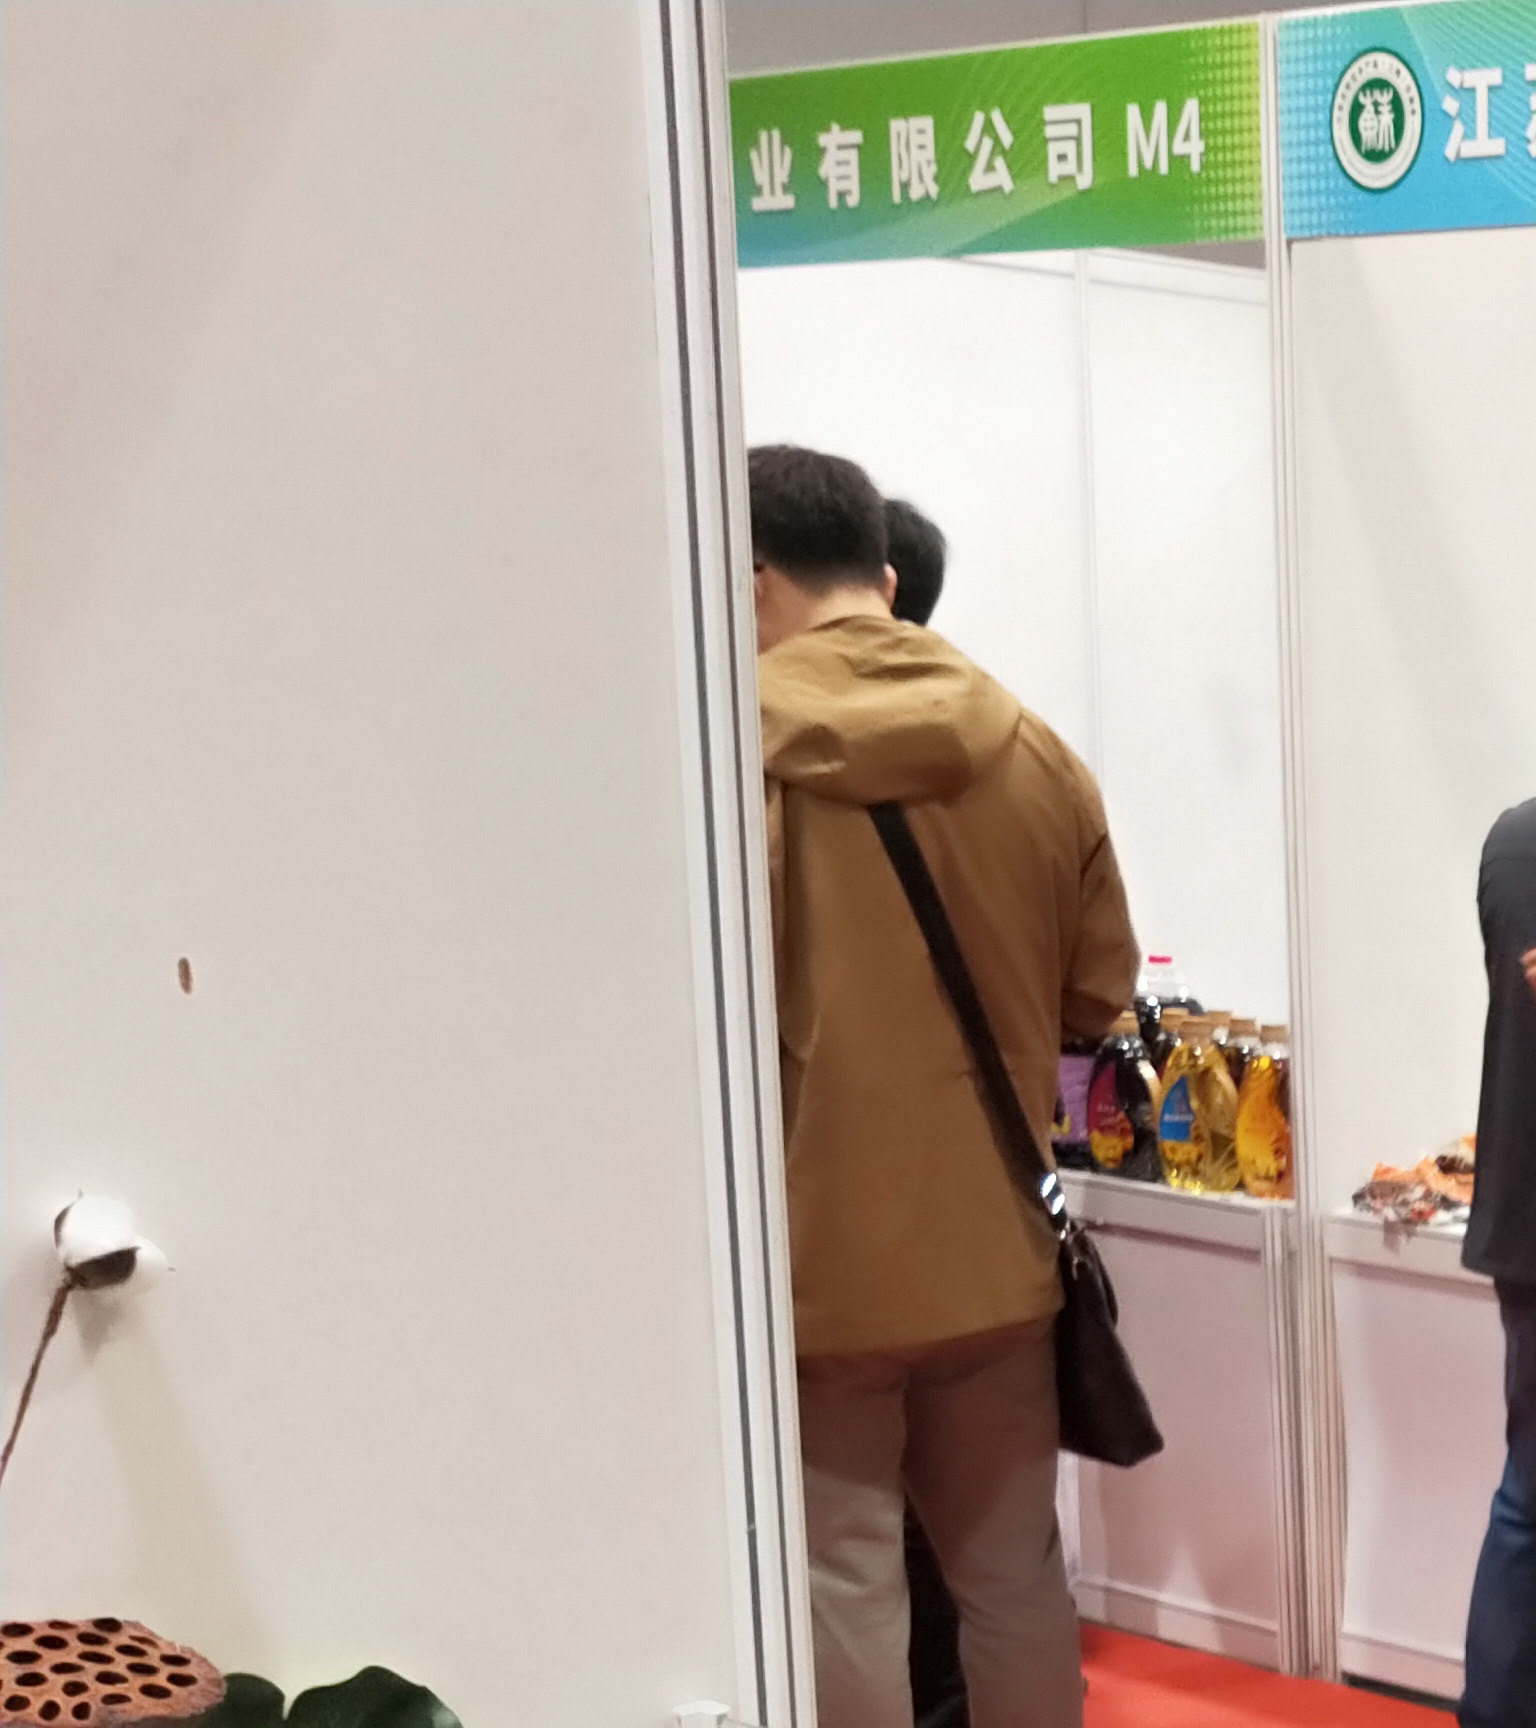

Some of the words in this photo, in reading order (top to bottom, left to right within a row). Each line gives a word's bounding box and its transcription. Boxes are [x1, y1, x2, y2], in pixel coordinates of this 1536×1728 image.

[749, 101, 1094, 213] 业有限公司
[1126, 97, 1205, 179] M4
